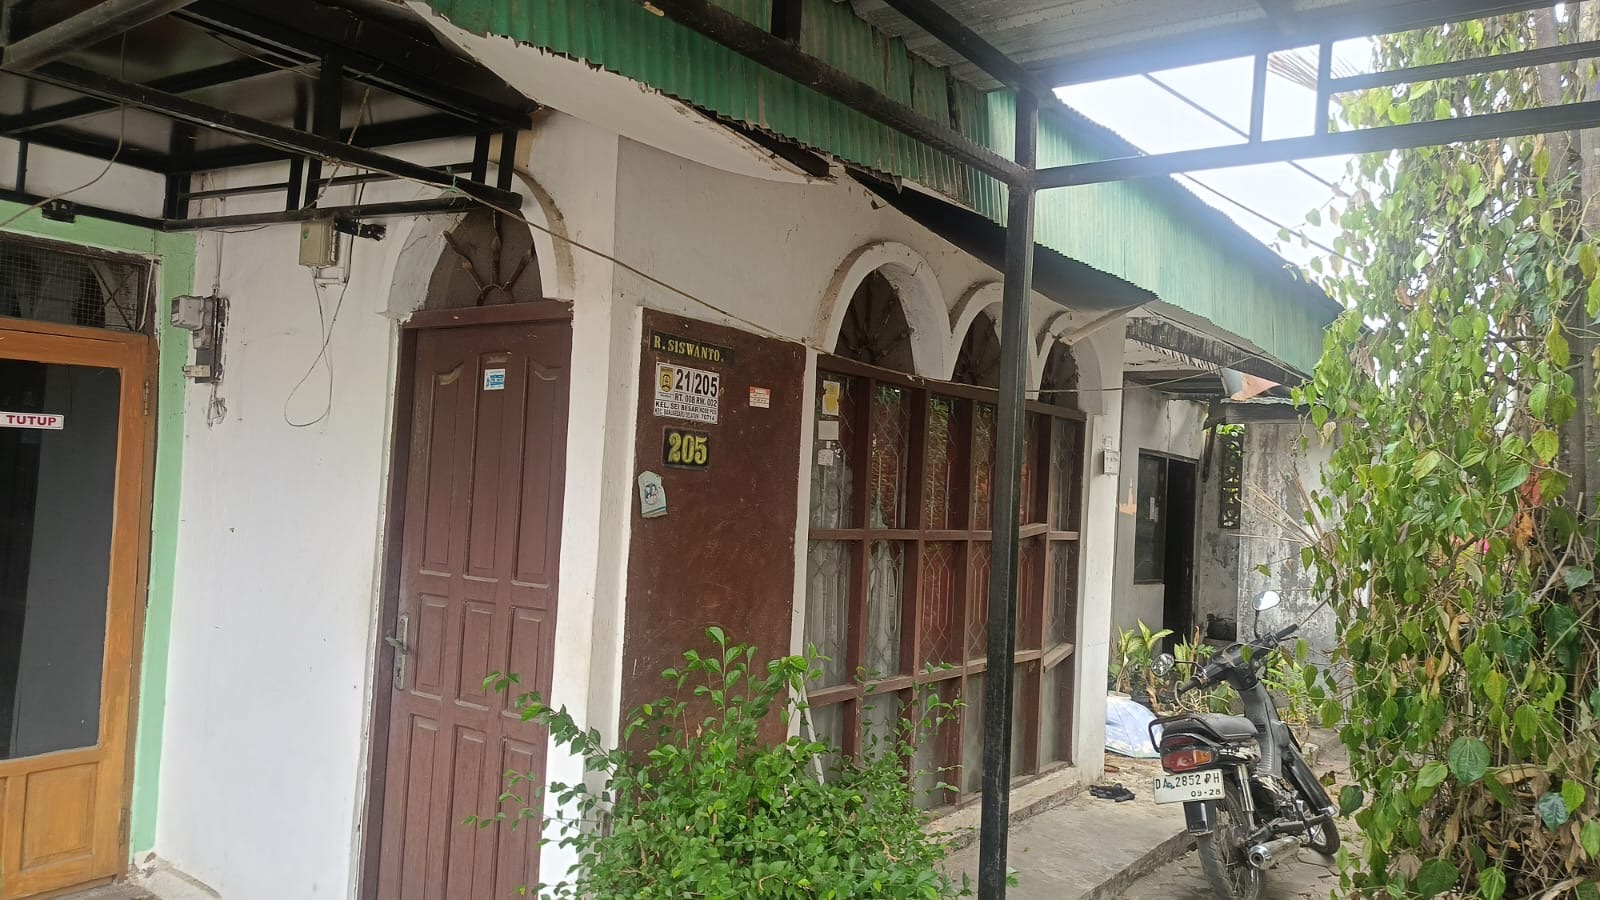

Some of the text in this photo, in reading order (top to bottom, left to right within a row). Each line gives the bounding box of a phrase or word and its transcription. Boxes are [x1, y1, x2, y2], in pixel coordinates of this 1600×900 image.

[675, 368, 718, 397] 21/205
[681, 404, 698, 412] BESAR
[6, 415, 56, 425] TUTUP
[668, 432, 707, 464] 205
[1175, 774, 1201, 788] 2852
